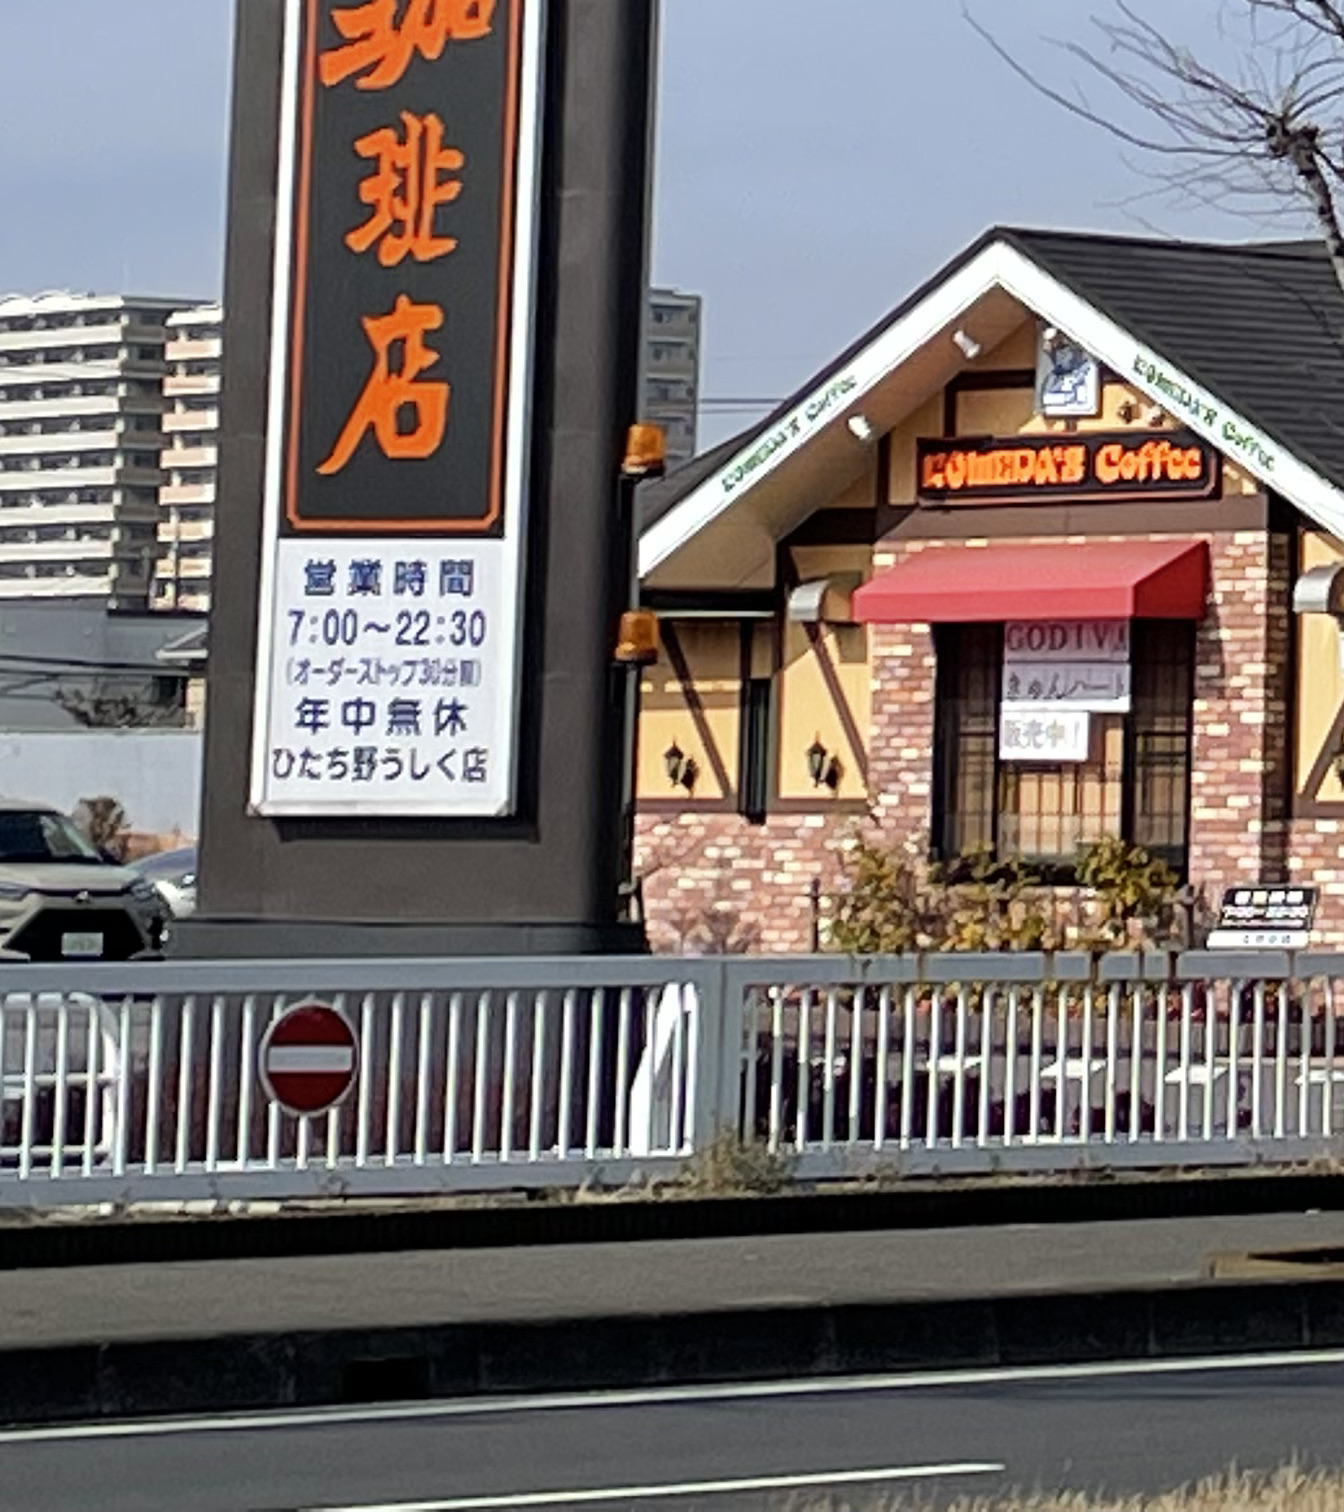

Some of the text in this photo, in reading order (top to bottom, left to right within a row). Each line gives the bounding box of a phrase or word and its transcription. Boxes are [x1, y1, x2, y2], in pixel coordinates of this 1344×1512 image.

[1095, 440, 1202, 484] Coffee
[303, 558, 475, 598] 営業時間
[286, 608, 487, 647] 7:00～22:30
[294, 696, 469, 737] 年中無休
[271, 745, 490, 783] ひたち野うしく店
